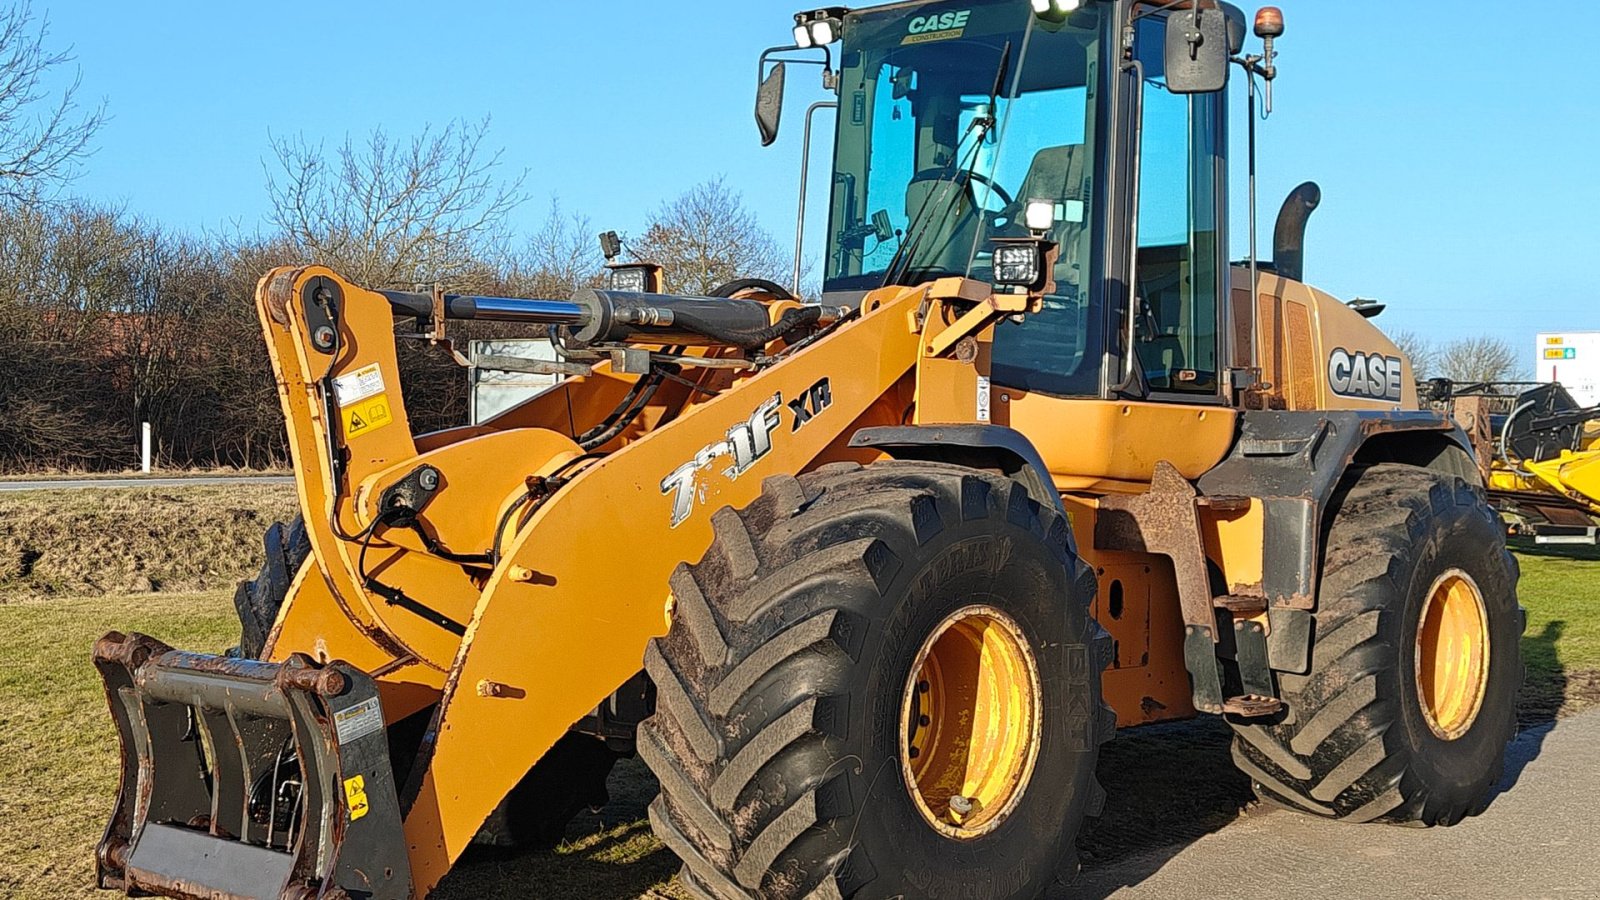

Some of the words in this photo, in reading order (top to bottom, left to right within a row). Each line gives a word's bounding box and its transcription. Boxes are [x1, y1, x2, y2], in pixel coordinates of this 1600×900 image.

[908, 10, 971, 34] CASE
[911, 29, 962, 43] CONSTRUCTION
[1328, 348, 1401, 400] CASE
[787, 376, 833, 434] XR
